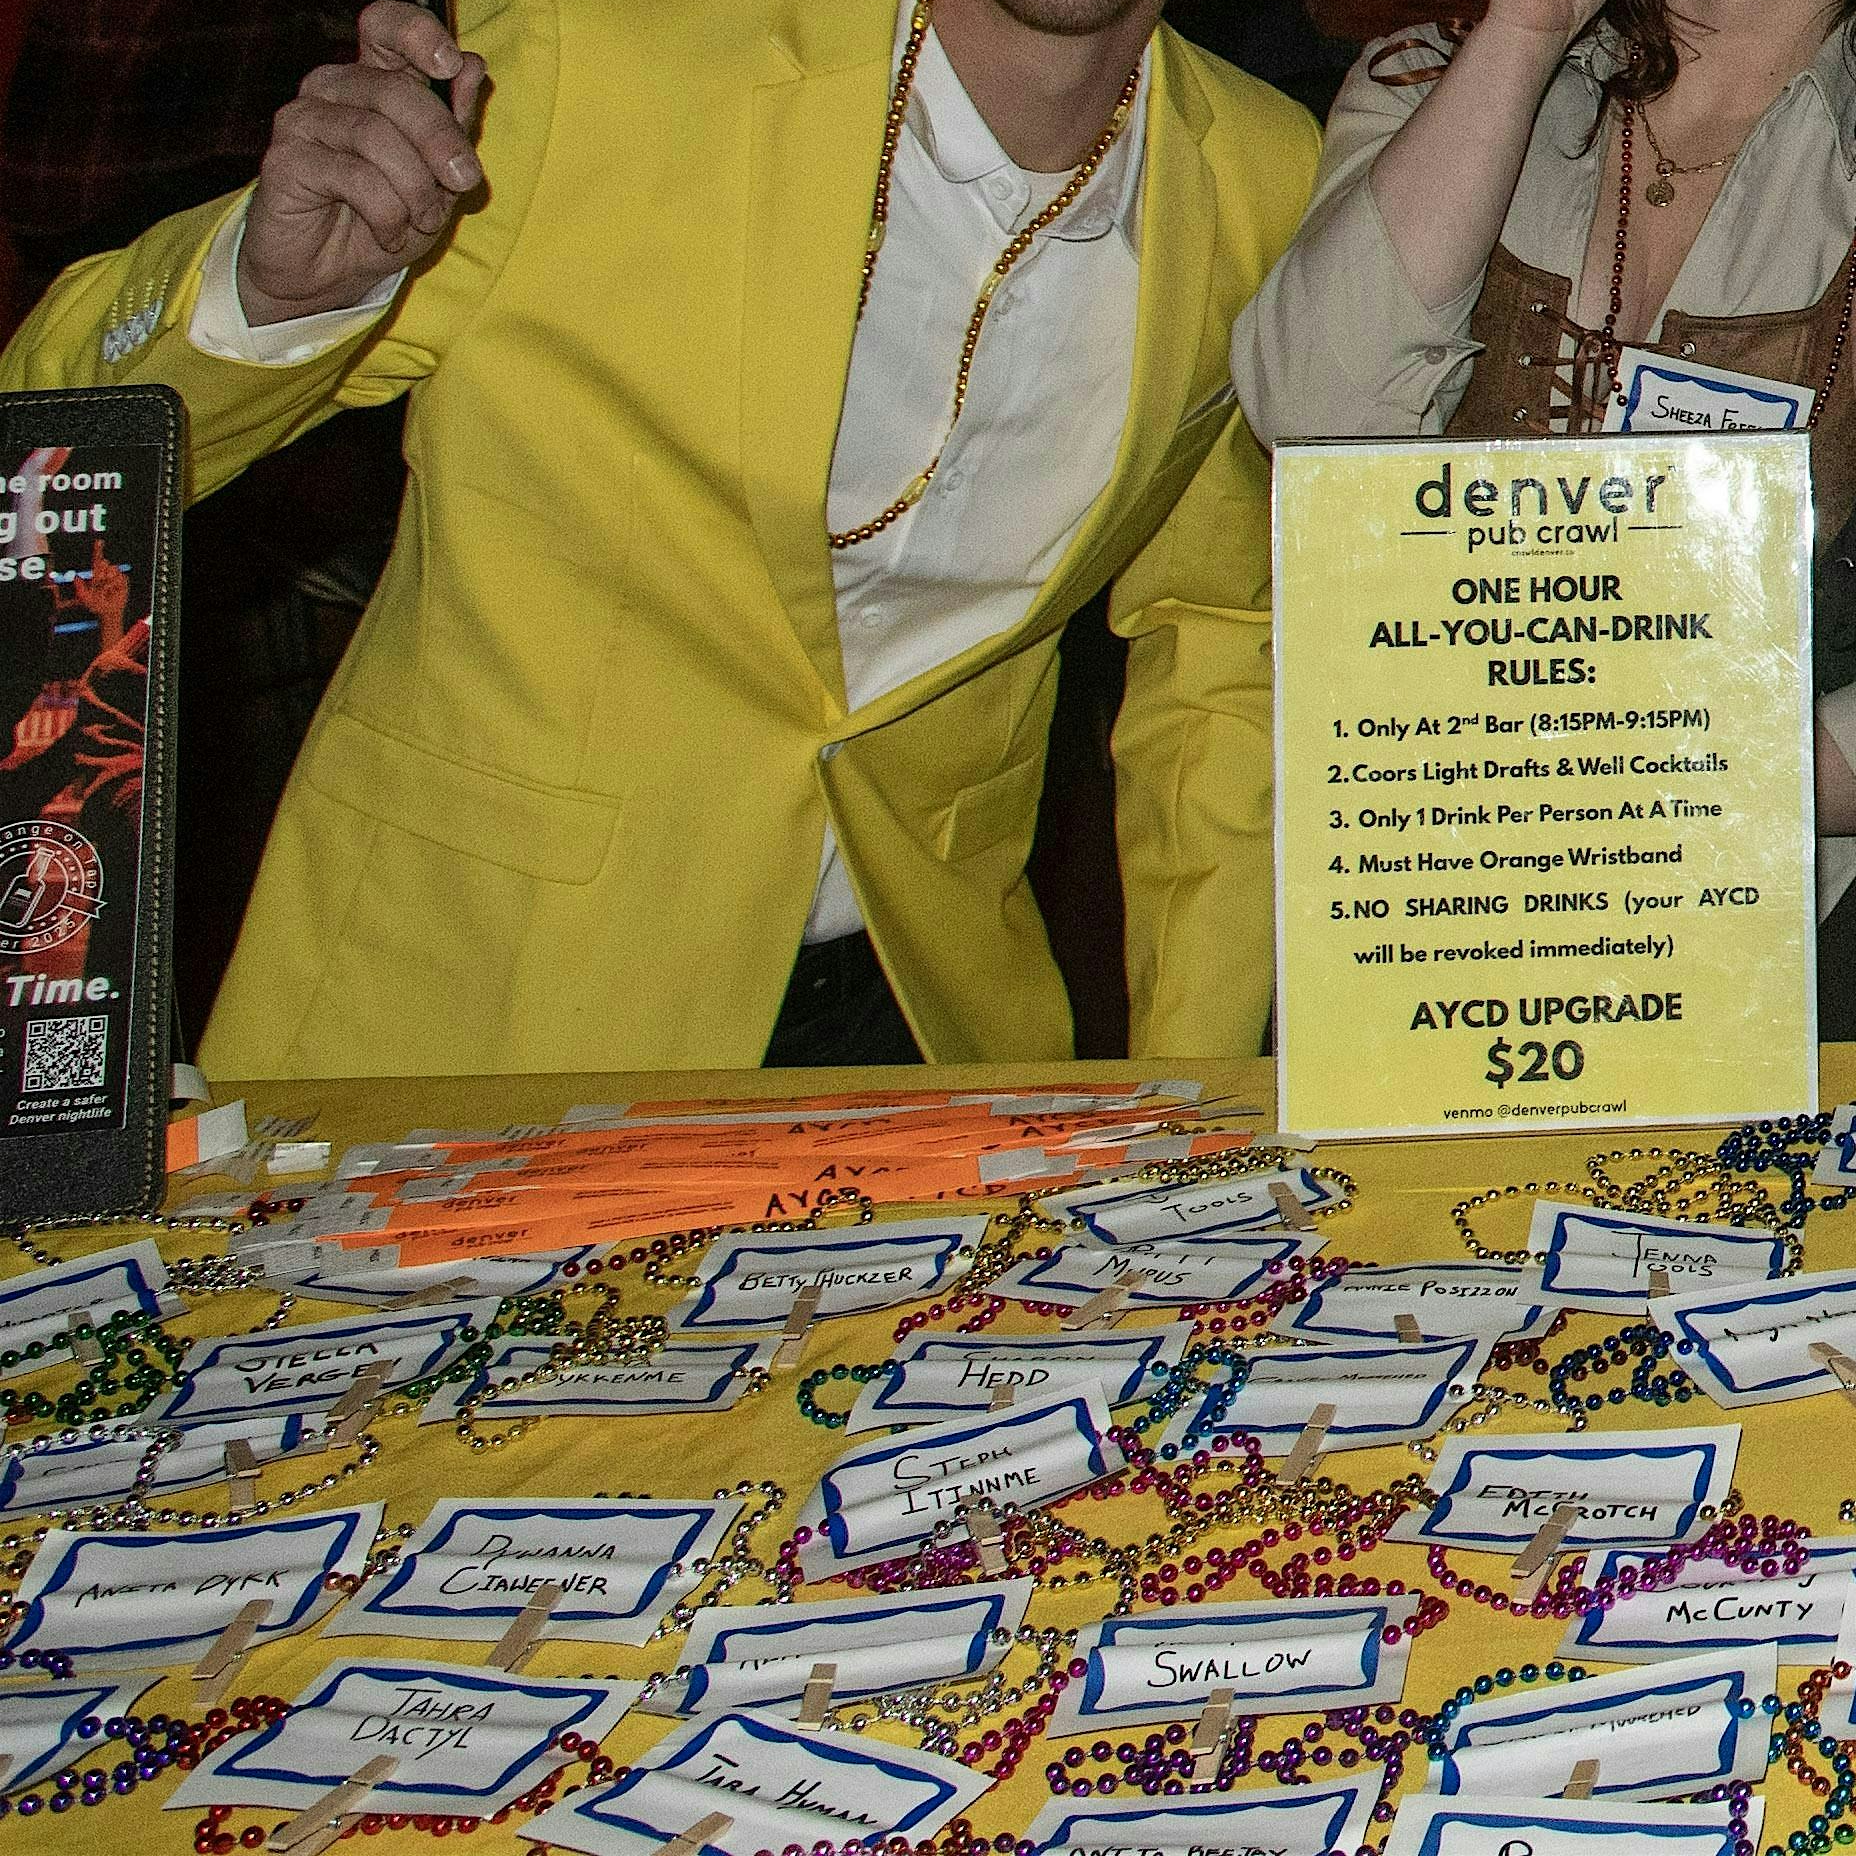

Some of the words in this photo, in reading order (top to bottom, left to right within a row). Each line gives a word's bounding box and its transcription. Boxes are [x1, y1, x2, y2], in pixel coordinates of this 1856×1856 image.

[1651, 396, 1711, 428] SHEEZA
[37, 468, 122, 494] room
[1415, 462, 1665, 518] denver
[35, 504, 106, 534] out
[1468, 521, 1526, 553] pub
[1537, 517, 1618, 544] crawl
[1451, 579, 1521, 605] ONE
[1530, 575, 1622, 603] HOUR
[1369, 613, 1713, 648] ALL-YOU-CAN-DRINK
[1488, 657, 1596, 686] RULES:
[1333, 719, 1349, 738] 1.
[1357, 718, 1410, 742] Only
[1415, 716, 1441, 737] At
[1485, 713, 1524, 734] Bar
[1530, 708, 1711, 737] (8:15PM-9:15PM)
[1353, 760, 1417, 782] Coors
[1423, 758, 1478, 784] Light
[1483, 758, 1550, 779] Drafts
[1557, 758, 1575, 777] &
[1578, 756, 1624, 777] Well
[1630, 753, 1728, 776] Cocktails
[1329, 809, 1350, 829] 3.
[1358, 806, 1411, 832] Only
[1417, 808, 1425, 826] 1
[1431, 804, 1490, 826] Drink
[1497, 804, 1533, 824] Per
[1540, 801, 1613, 823] Person
[1618, 800, 1643, 819] At
[1649, 800, 1666, 819] A
[1671, 797, 1722, 819] Time
[7, 973, 122, 1009] Time.
[1410, 999, 1509, 1031] AYCD
[1518, 992, 1683, 1026] UPGRADE
[1485, 1037, 1585, 1089] $20
[9, 1113, 56, 1125] Denver
[58, 1107, 112, 1122] nightlife
[16, 1100, 60, 1110] Create
[62, 1098, 70, 1106] a
[73, 1094, 108, 1105] safer
[1443, 1106, 1493, 1120] venmo
[1498, 1100, 1627, 1120] @denverpubcrawl
[959, 1362, 1050, 1388] HEDD
[1146, 1649, 1312, 1688] SWALLOW
[396, 1688, 495, 1722] TAHRA
[351, 1715, 470, 1760] DACTYL
